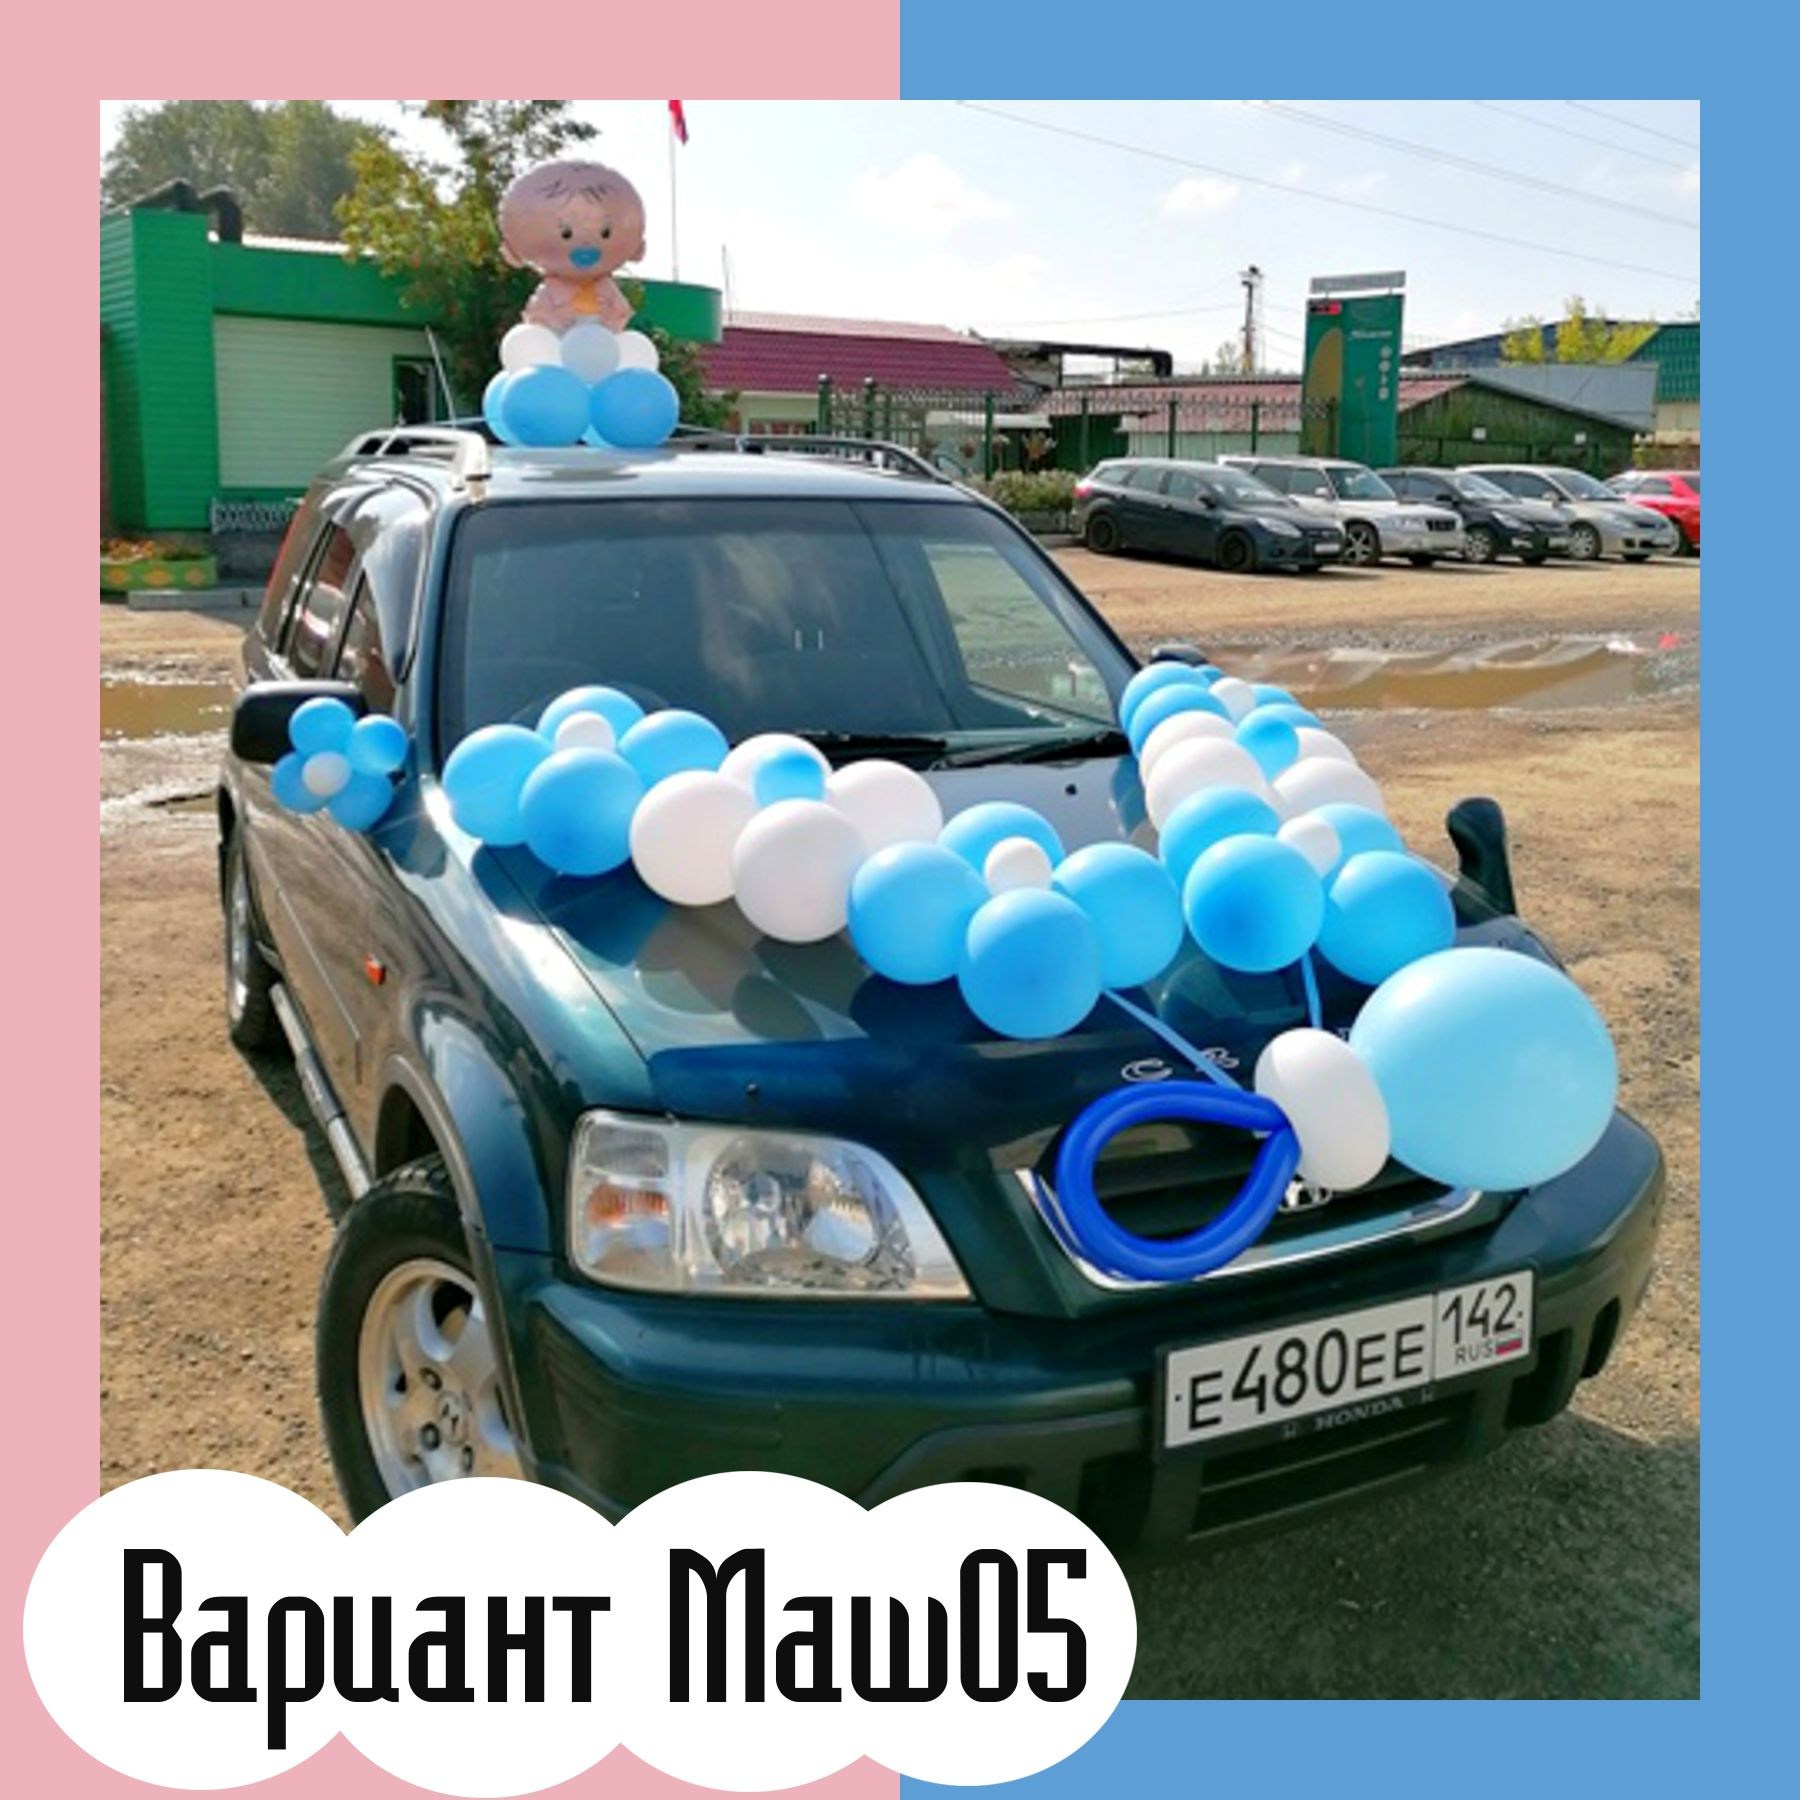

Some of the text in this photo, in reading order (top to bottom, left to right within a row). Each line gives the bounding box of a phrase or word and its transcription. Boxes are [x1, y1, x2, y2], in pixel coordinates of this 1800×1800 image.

[1441, 1283, 1517, 1344] 142
[1188, 1323, 1425, 1431] Е480ЕЕ
[1455, 1344, 1494, 1365] RUS
[1314, 1396, 1404, 1432] HONDA
